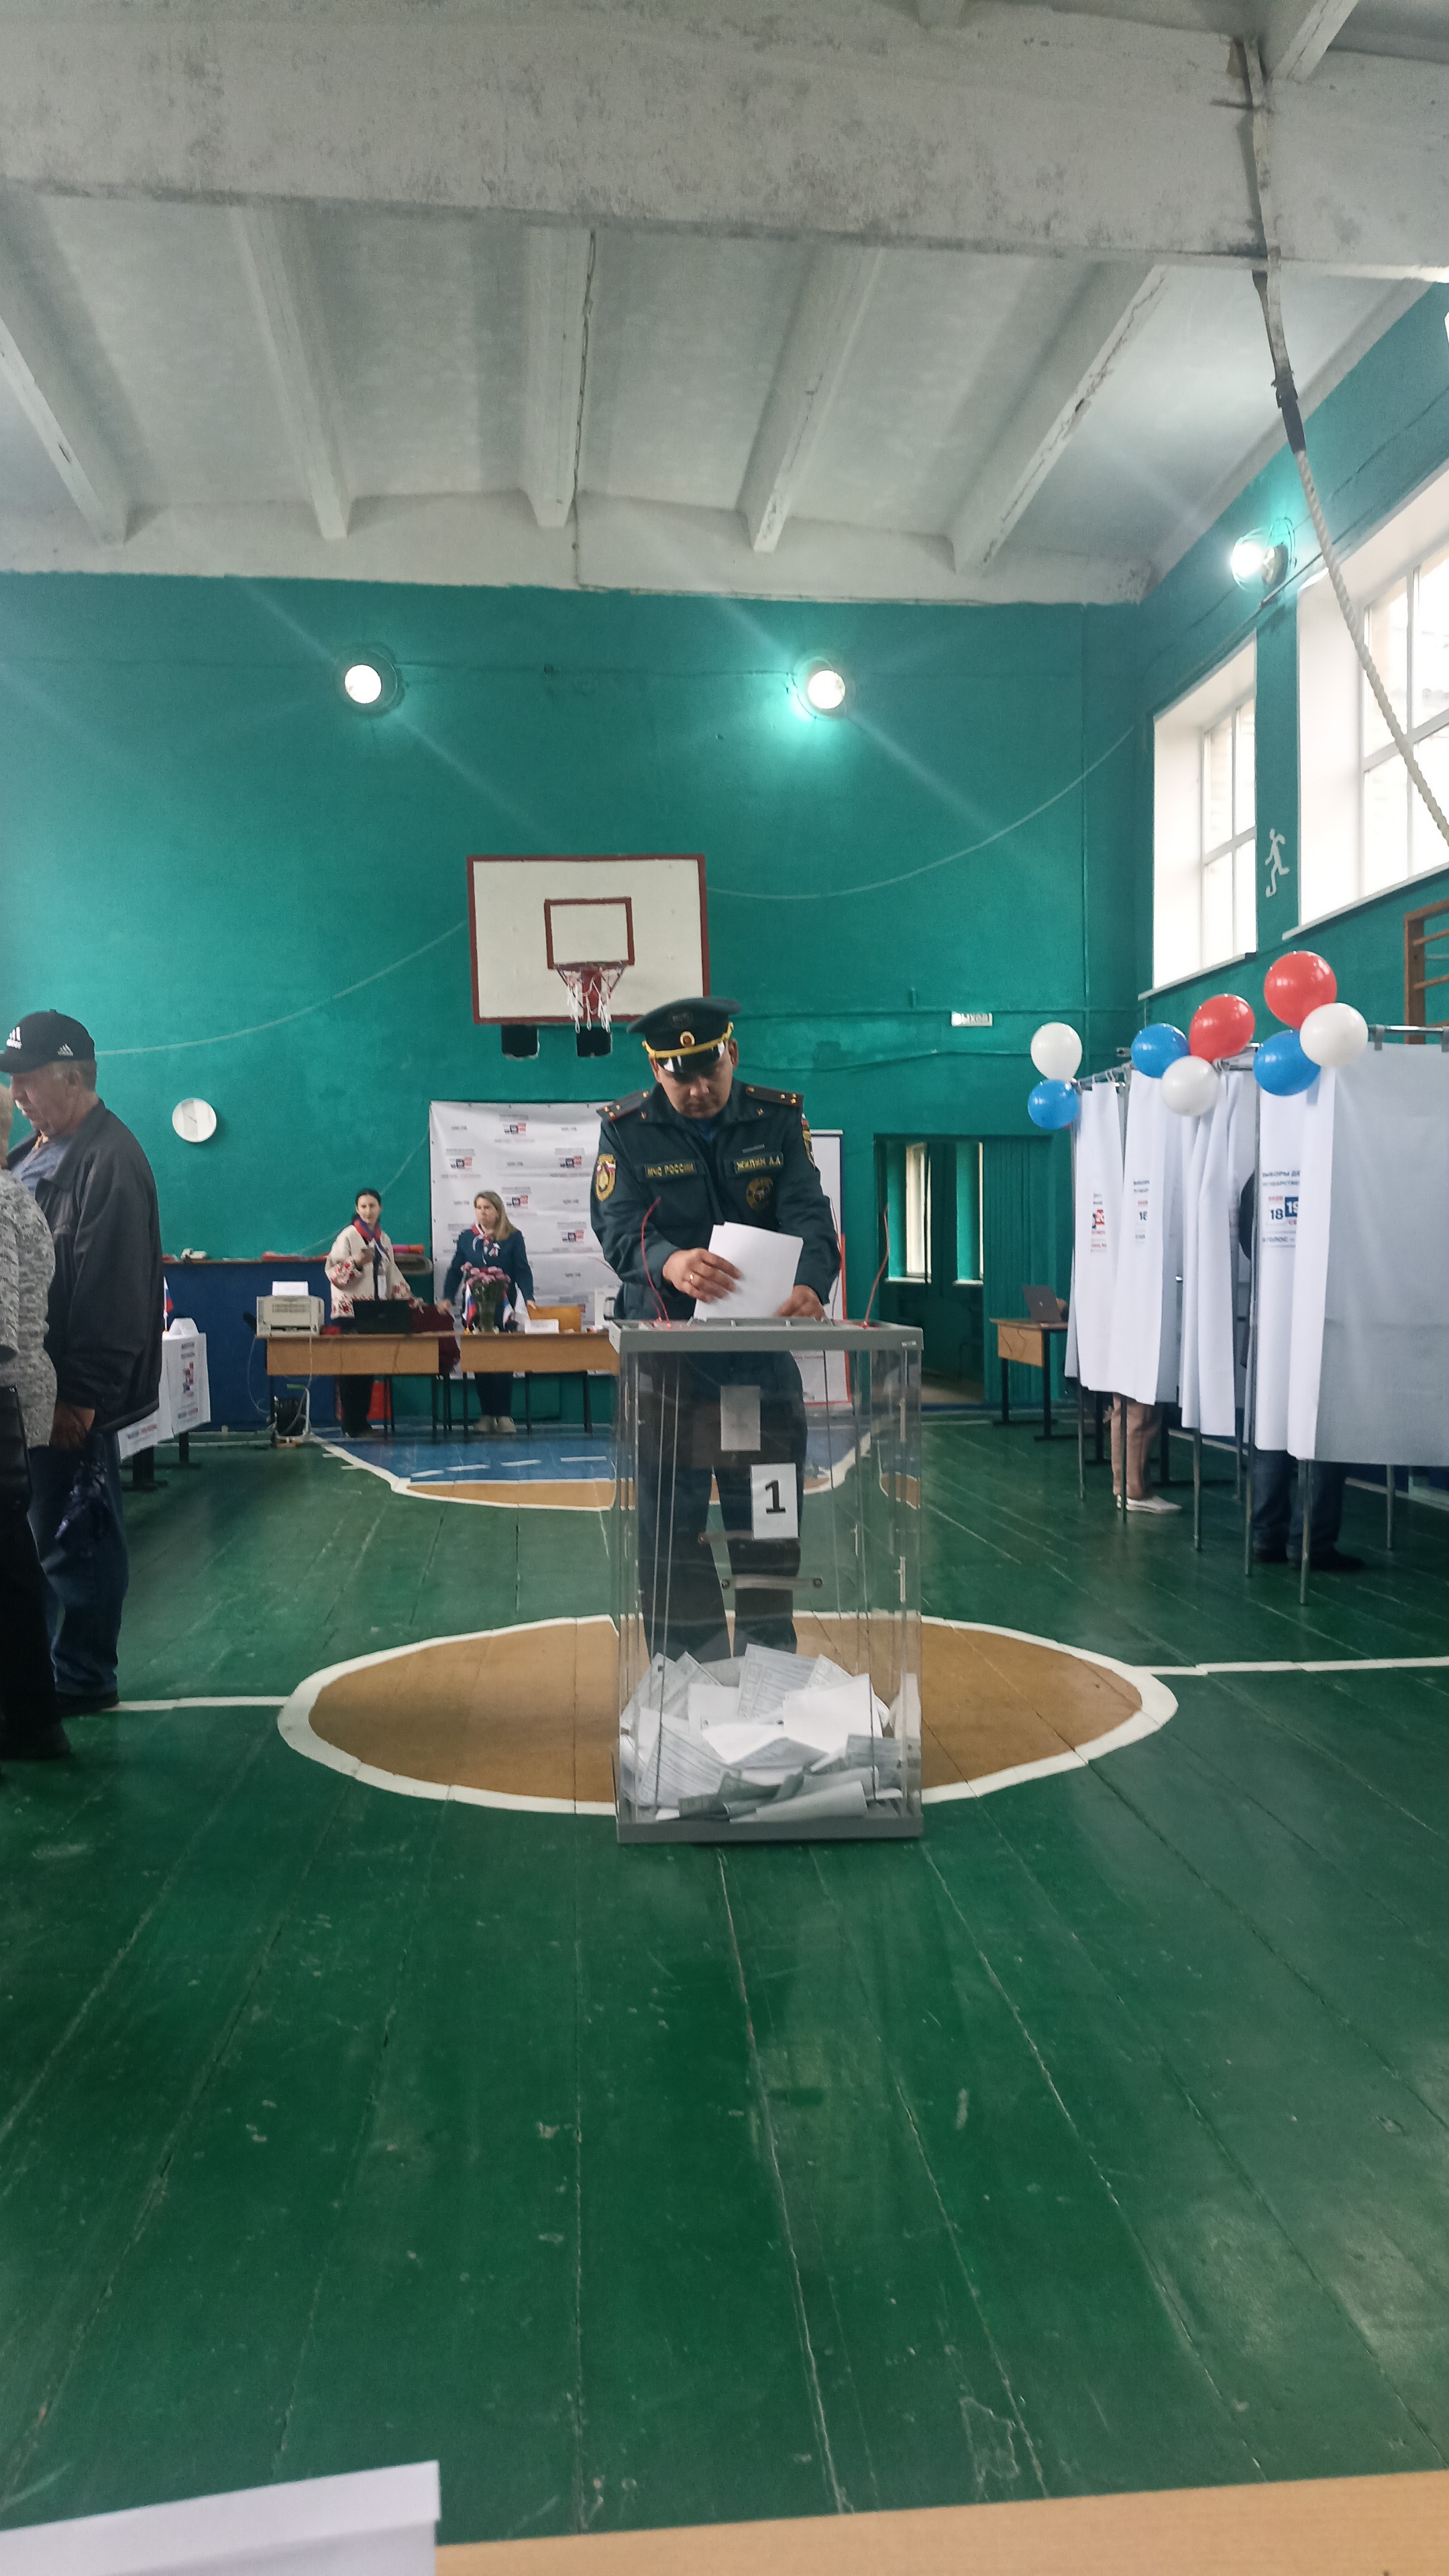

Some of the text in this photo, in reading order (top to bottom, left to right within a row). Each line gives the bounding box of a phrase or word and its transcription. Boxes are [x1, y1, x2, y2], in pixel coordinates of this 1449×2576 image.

[647, 1163, 695, 1177] МЧС РОССИИ
[1270, 1208, 1283, 1220] 18
[765, 1480, 786, 1514] 1
